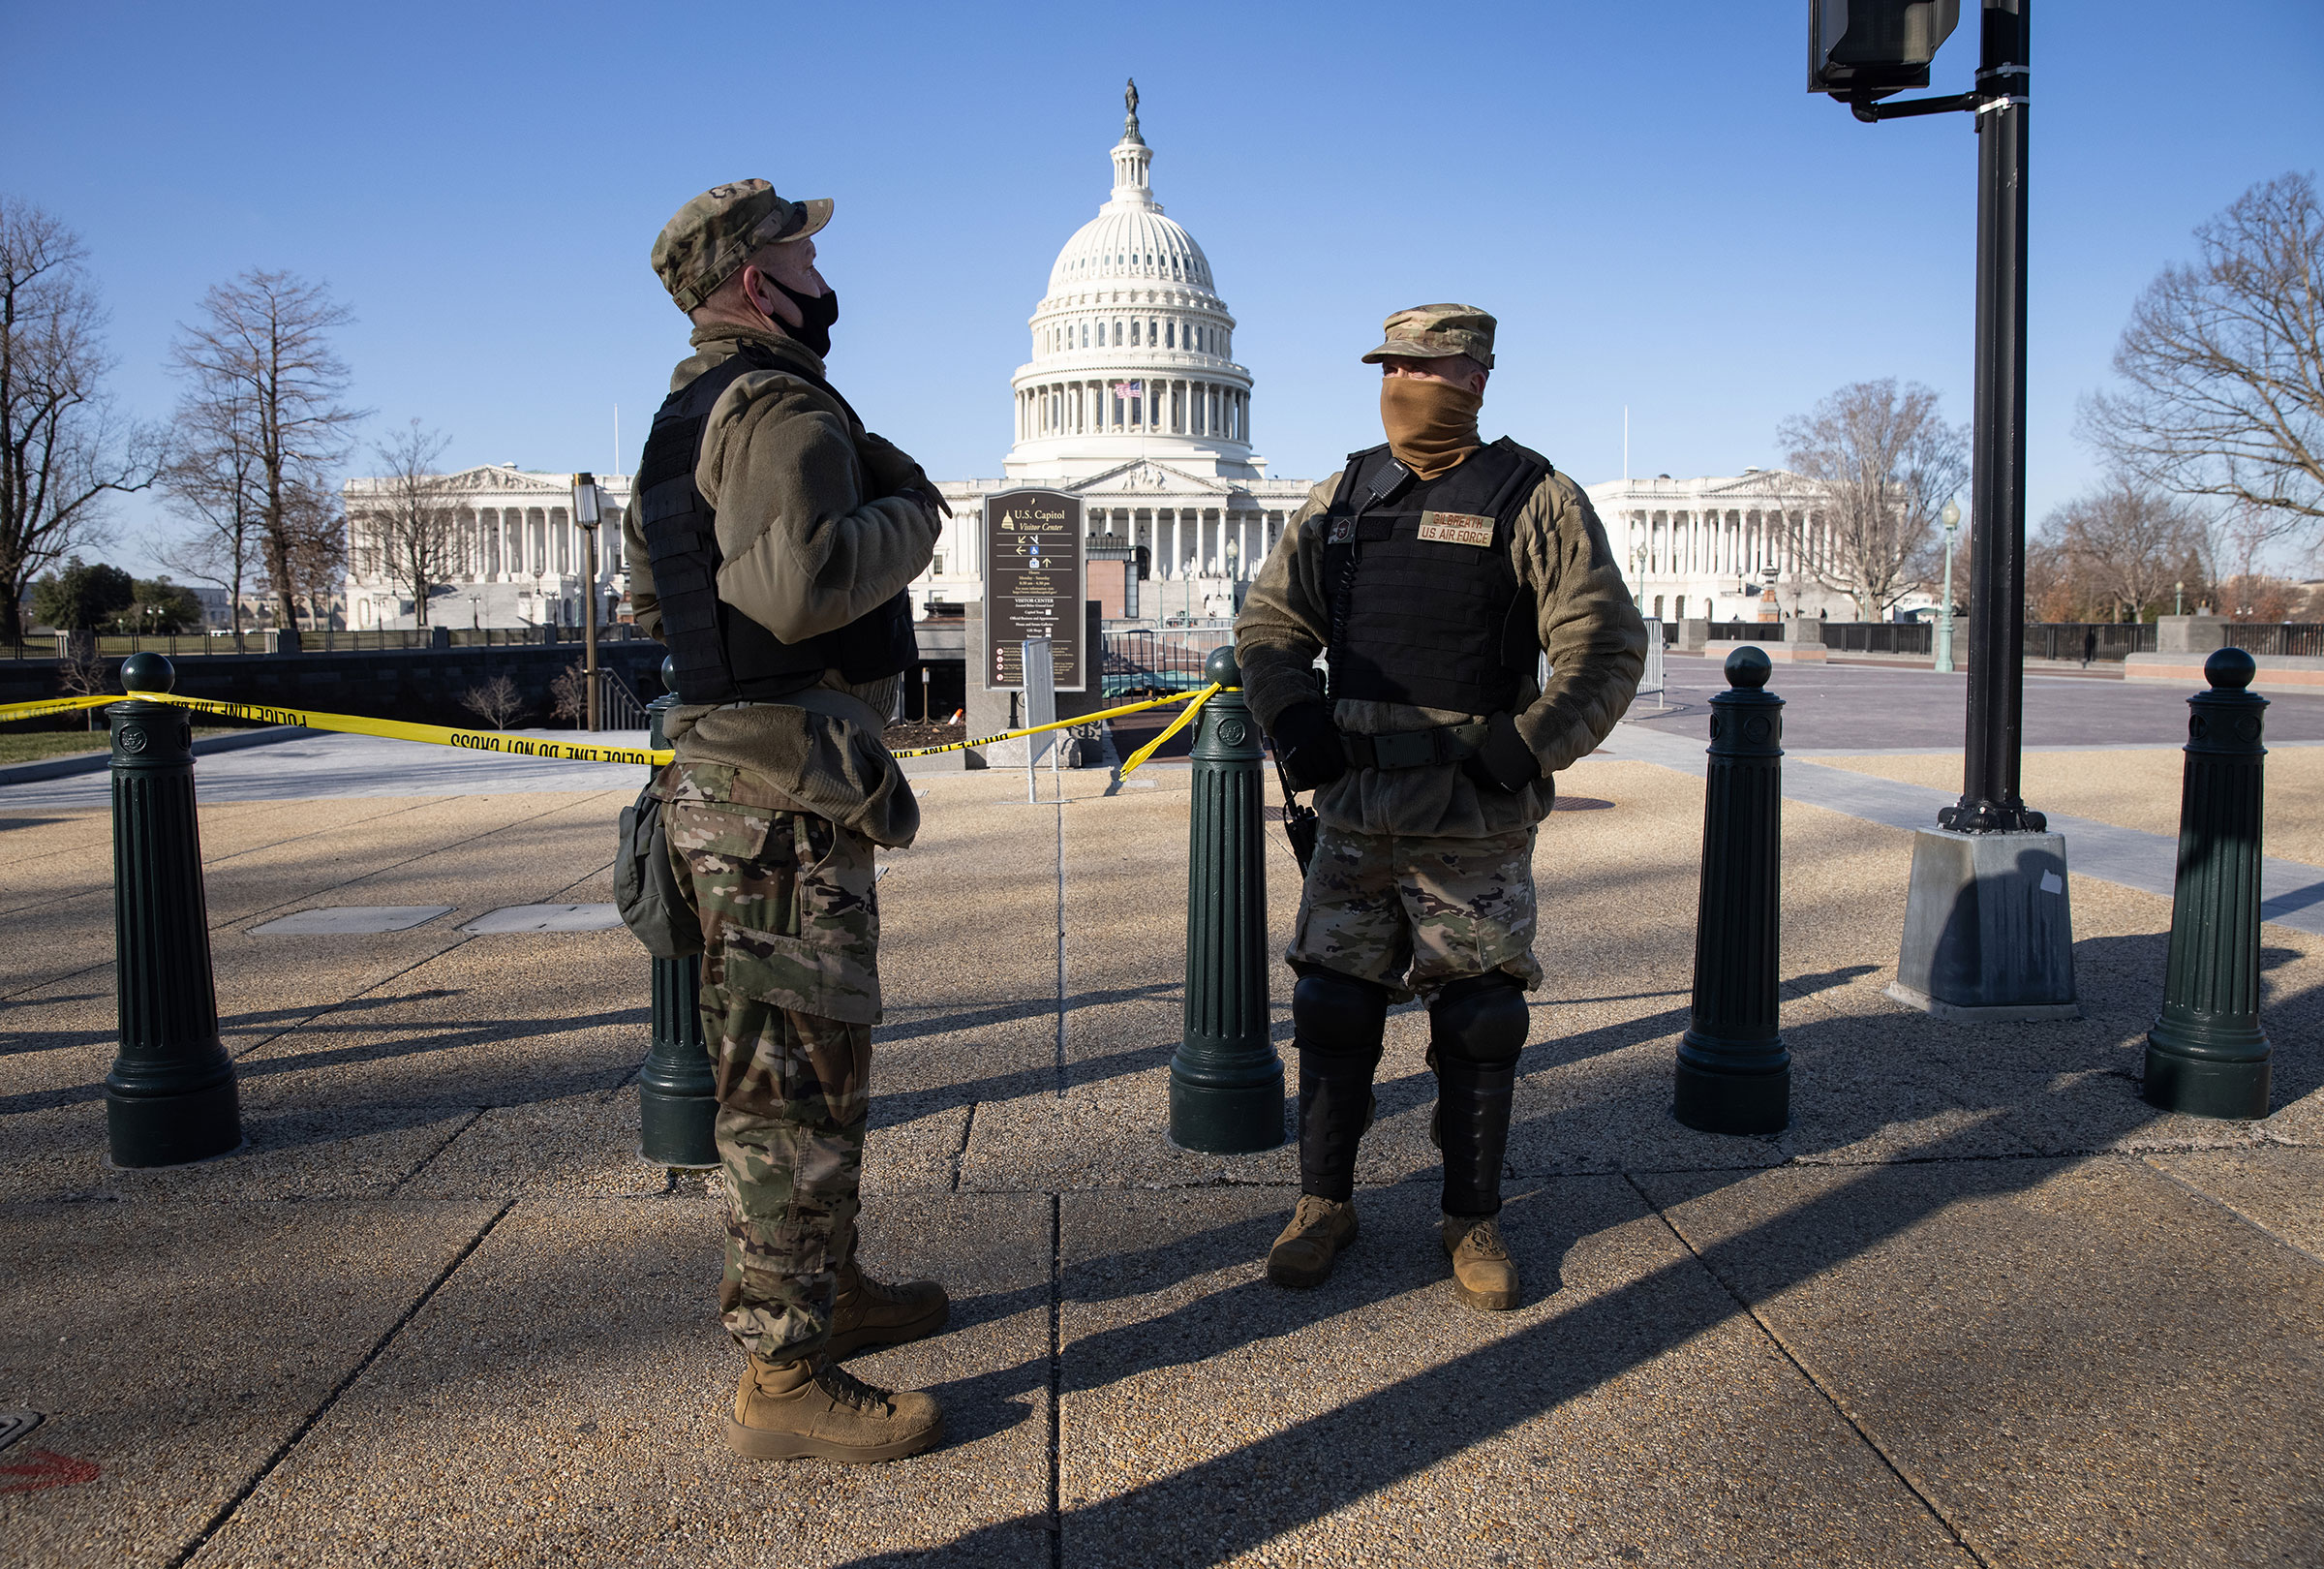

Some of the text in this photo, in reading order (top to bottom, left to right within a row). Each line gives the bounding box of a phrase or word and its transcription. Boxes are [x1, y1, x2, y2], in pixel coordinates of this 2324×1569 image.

[1014, 509, 1065, 522] U.S. Capitol
[1433, 513, 1483, 529] GILBREATH
[1439, 529, 1454, 540] AIR
[1456, 530, 1488, 543] FORCE
